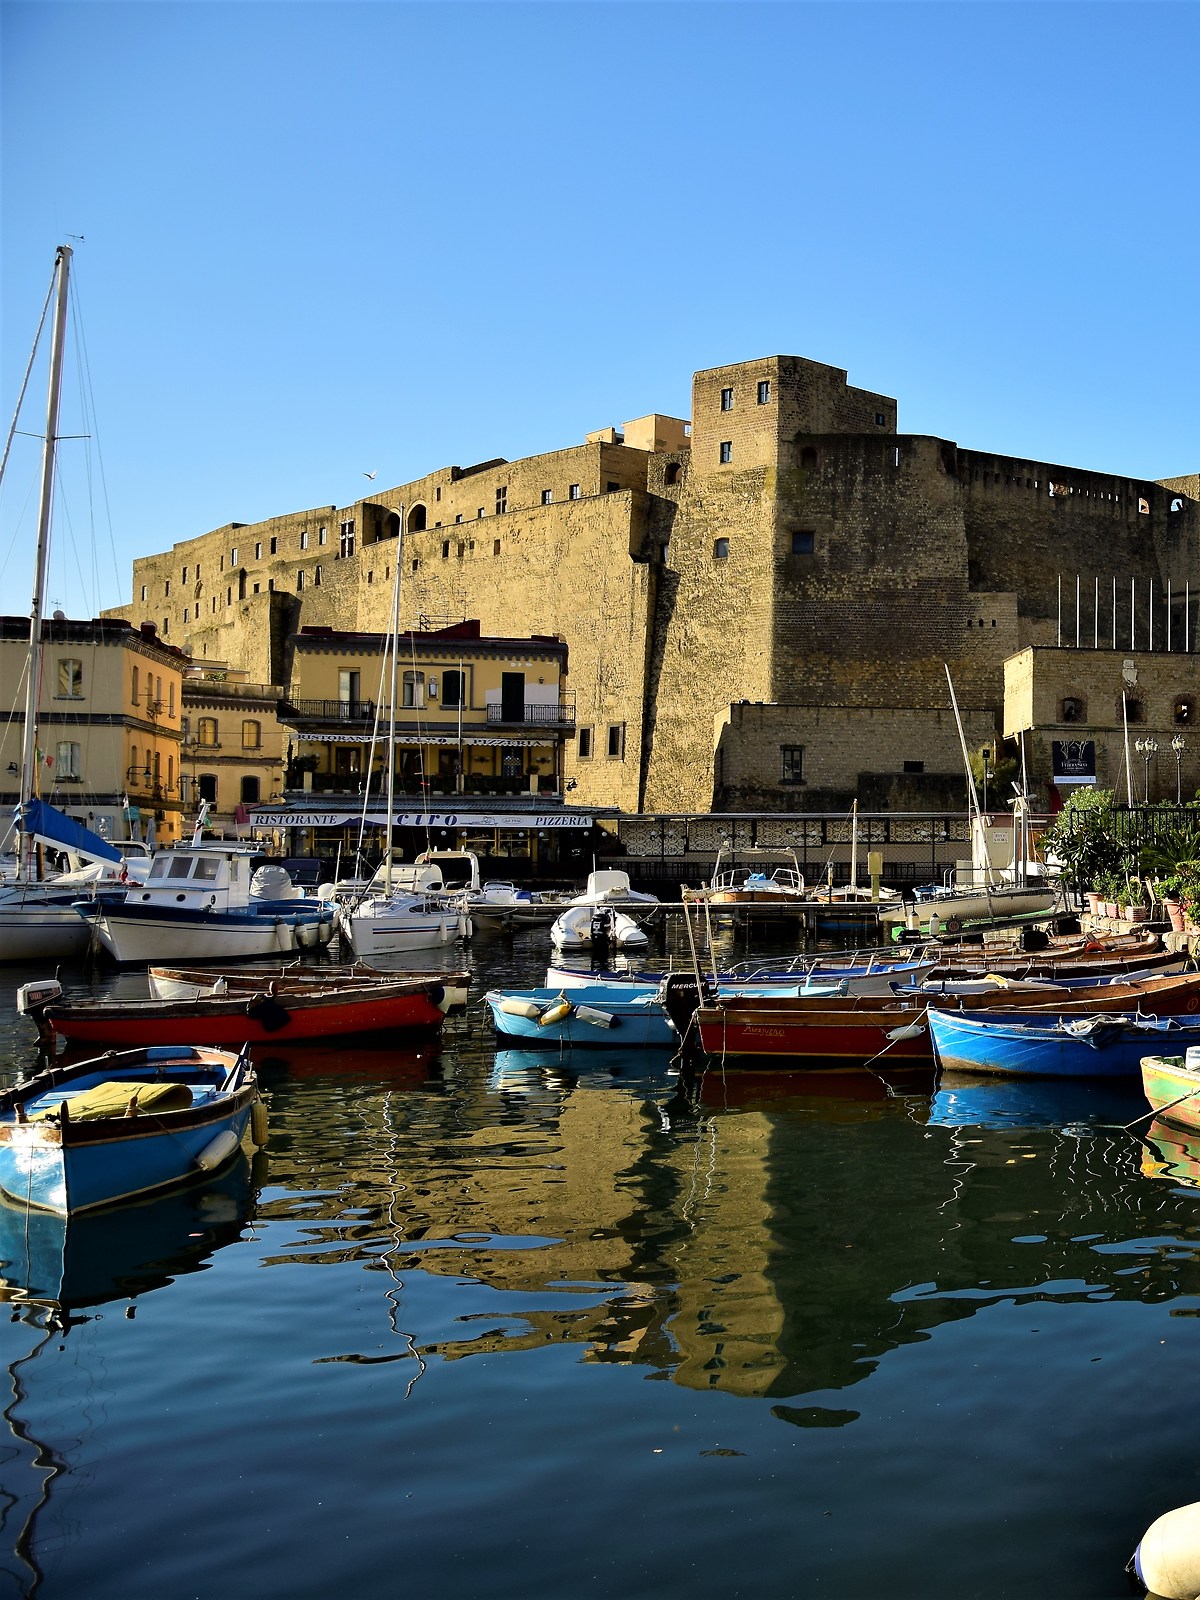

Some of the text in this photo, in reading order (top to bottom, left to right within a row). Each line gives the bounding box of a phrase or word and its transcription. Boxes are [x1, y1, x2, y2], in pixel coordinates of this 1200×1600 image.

[255, 815, 338, 825] RISTORANTE
[535, 817, 589, 826] PIZZERIA
[671, 981, 706, 989] MERCUY
